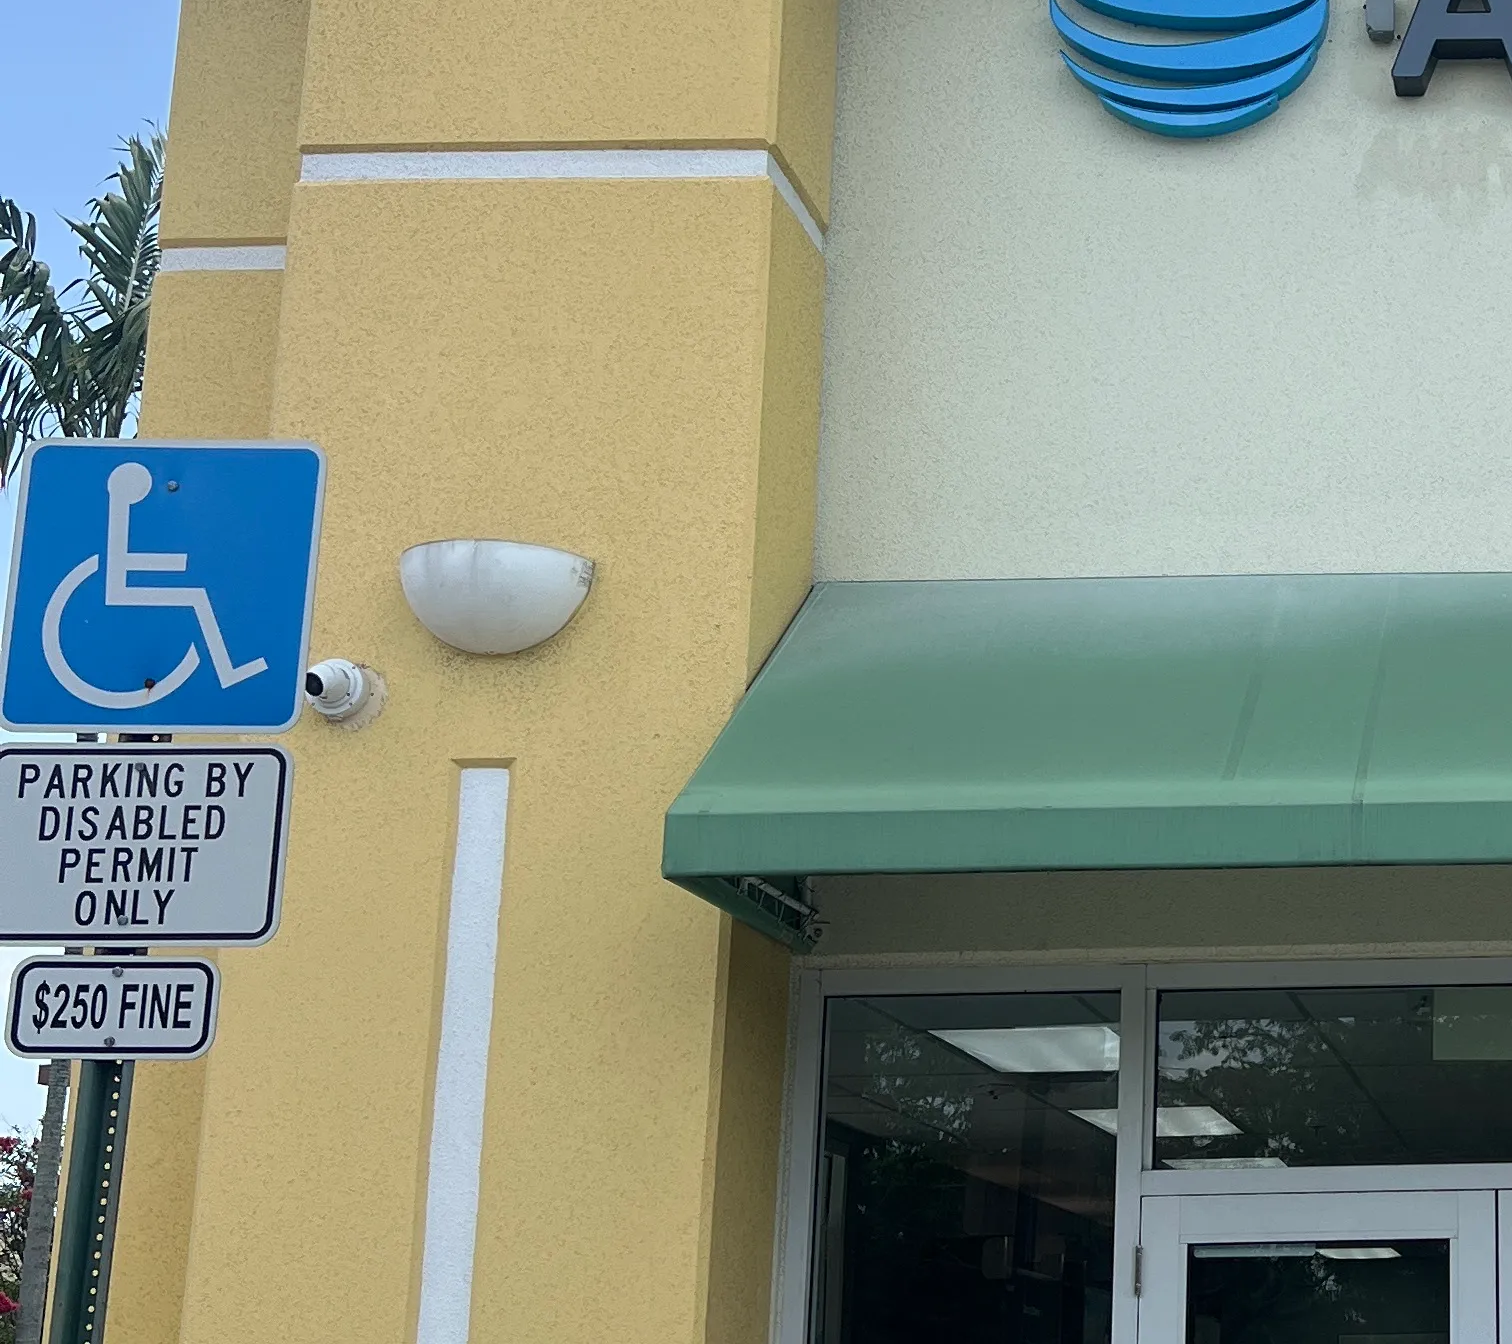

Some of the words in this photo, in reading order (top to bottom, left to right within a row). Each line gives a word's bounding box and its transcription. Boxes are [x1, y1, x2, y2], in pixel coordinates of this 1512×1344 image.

[18, 763, 184, 799] PARKING
[205, 762, 255, 798] BY
[38, 805, 225, 841] DISABLED
[58, 847, 198, 883] PERMIT
[73, 889, 175, 926] ONLY
[32, 980, 107, 1033] $250
[119, 983, 193, 1030] FINE
